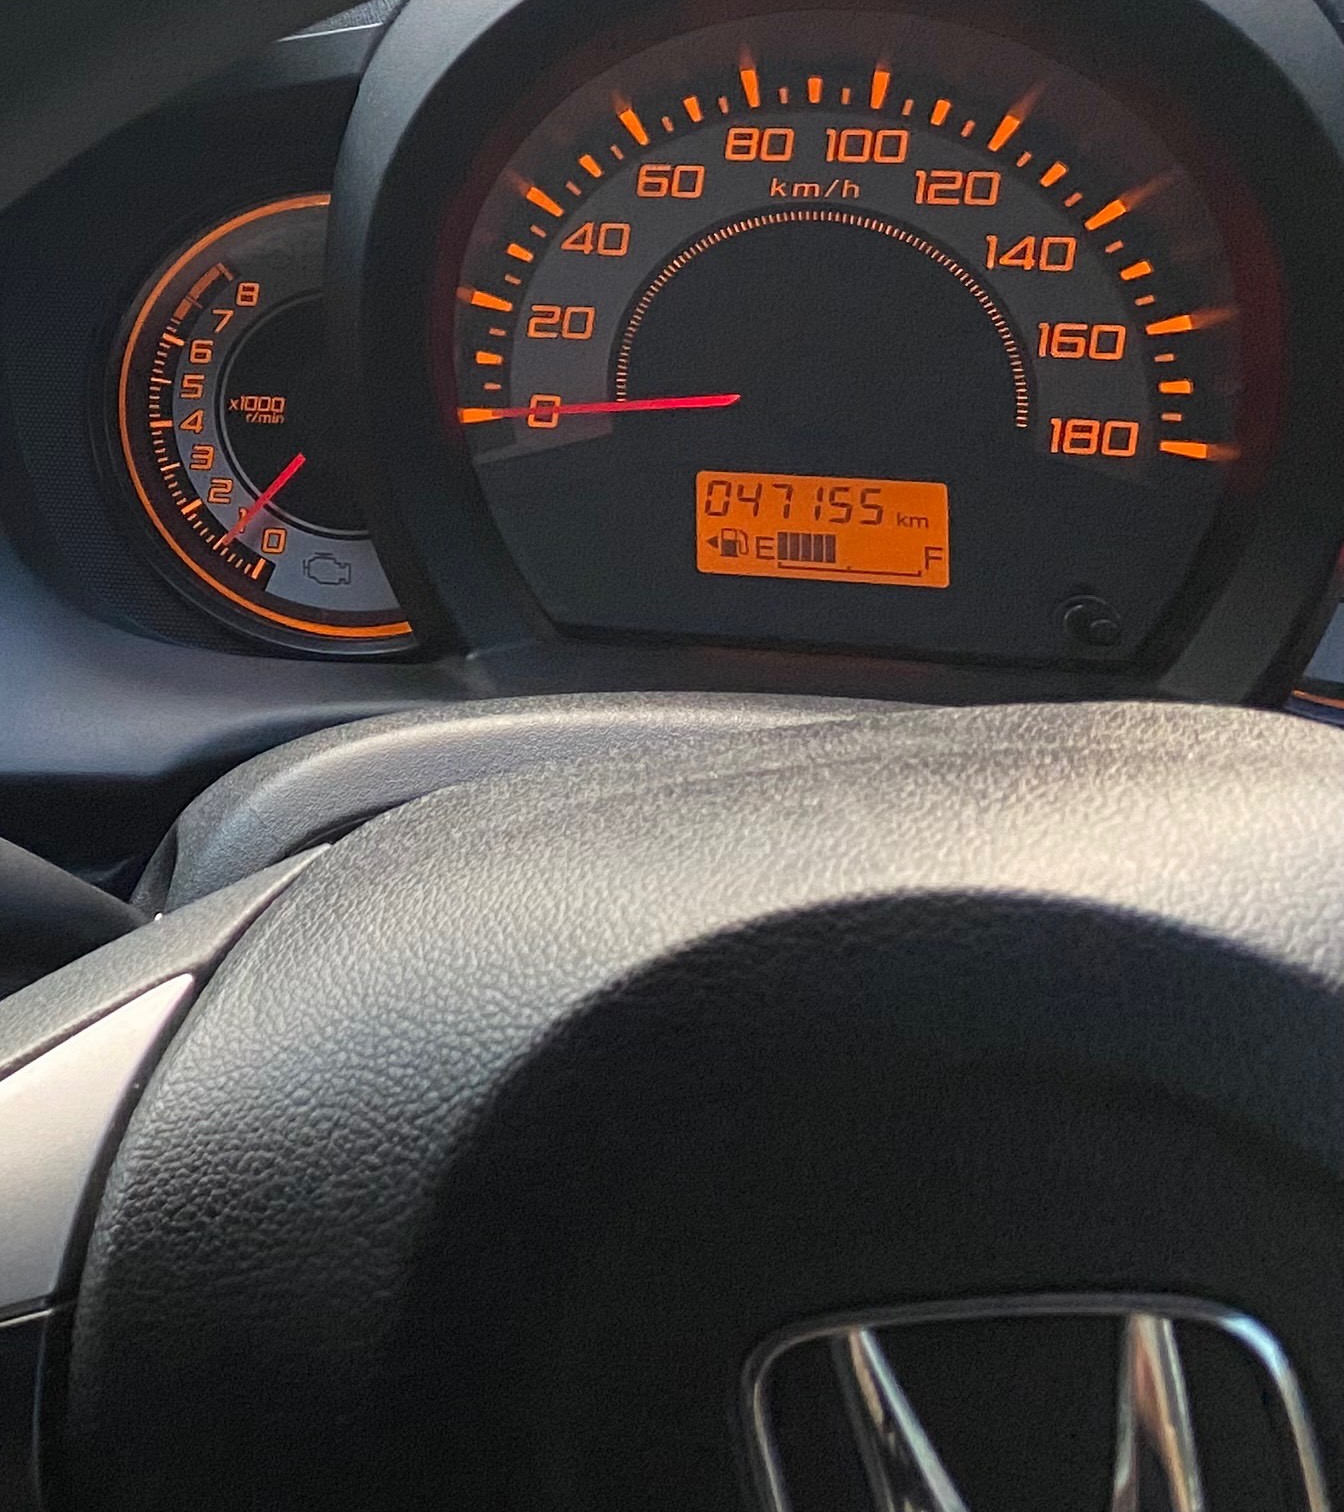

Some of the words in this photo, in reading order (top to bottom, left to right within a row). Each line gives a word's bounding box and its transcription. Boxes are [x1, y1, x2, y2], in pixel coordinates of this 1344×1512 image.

[724, 127, 794, 163] 80
[825, 127, 909, 164] 100
[636, 163, 705, 198] 60
[769, 177, 860, 199] km/h
[914, 169, 1001, 206] 120
[561, 222, 631, 257] 40
[985, 235, 1076, 272] 140
[236, 280, 260, 307] 8
[212, 308, 234, 333] 7
[526, 305, 595, 340] 20
[188, 339, 214, 365] 6
[1037, 322, 1127, 361] 160
[179, 373, 205, 400] 5
[228, 396, 286, 414] x1000
[245, 411, 286, 425] r/min
[526, 394, 561, 429] 0
[178, 408, 205, 434] 4
[1048, 418, 1140, 457] 180
[189, 444, 215, 472] 3
[207, 477, 233, 504] 2
[705, 479, 884, 526] 047155
[896, 510, 930, 530] km
[261, 527, 287, 555] 0
[755, 535, 777, 561] E
[924, 546, 944, 572] F
